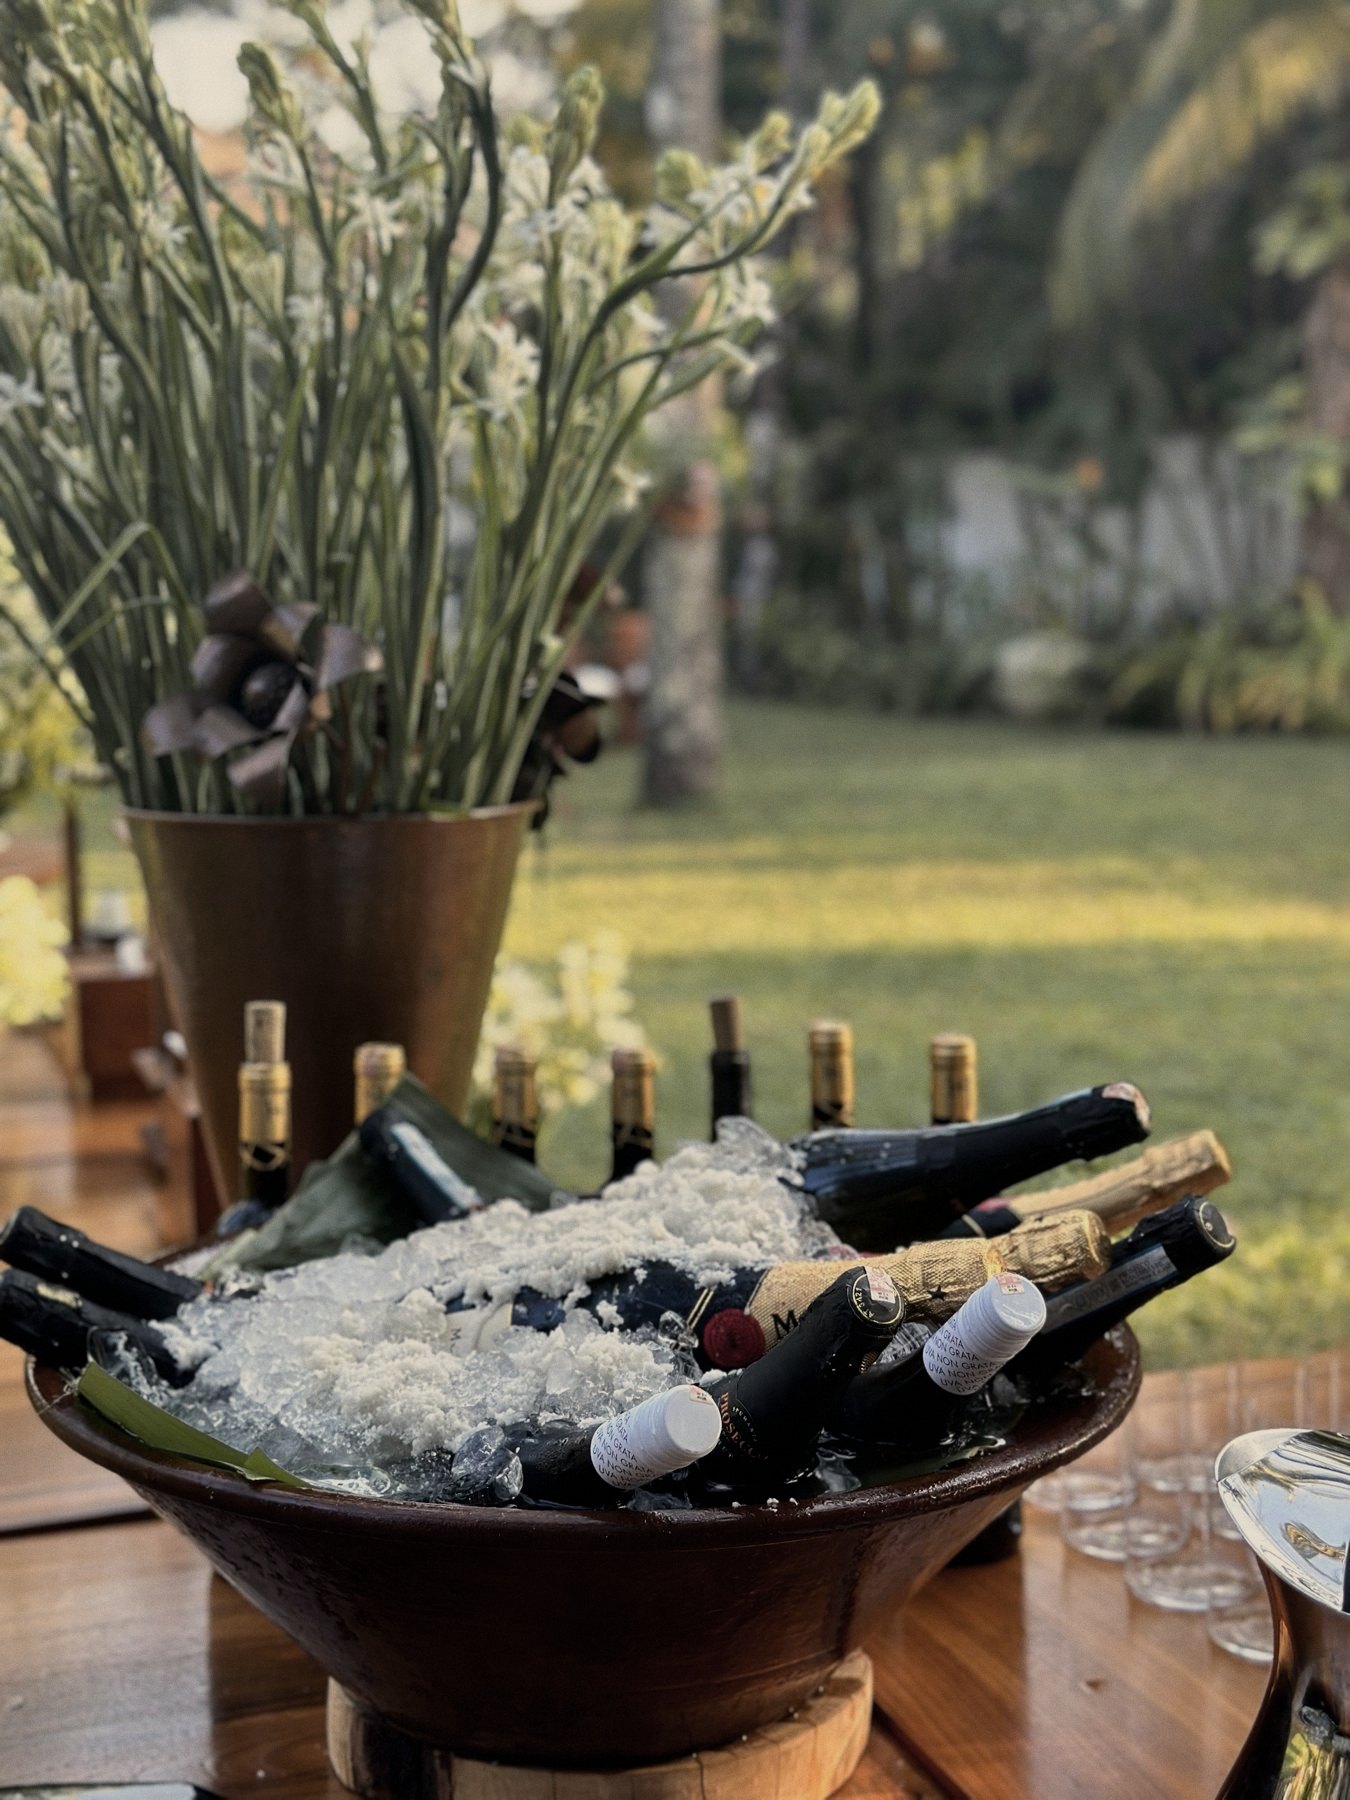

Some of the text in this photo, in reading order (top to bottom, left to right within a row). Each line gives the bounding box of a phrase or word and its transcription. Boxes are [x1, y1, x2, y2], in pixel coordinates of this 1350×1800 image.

[943, 1329, 965, 1349] GRATA
[936, 1353, 958, 1369] NON
[961, 1361, 996, 1370] GRATA
[948, 1346, 980, 1361] GRATA
[928, 1361, 946, 1376] UVA
[948, 1369, 975, 1379] NON
[940, 1378, 963, 1387] UVA
[720, 1392, 768, 1460] PROSECC
[601, 1440, 618, 1461] NON
[620, 1458, 653, 1474] GRATA
[613, 1438, 638, 1463] GRATA
[592, 1444, 606, 1463] UVA
[607, 1460, 632, 1477] NON
[598, 1465, 618, 1480] UVA
